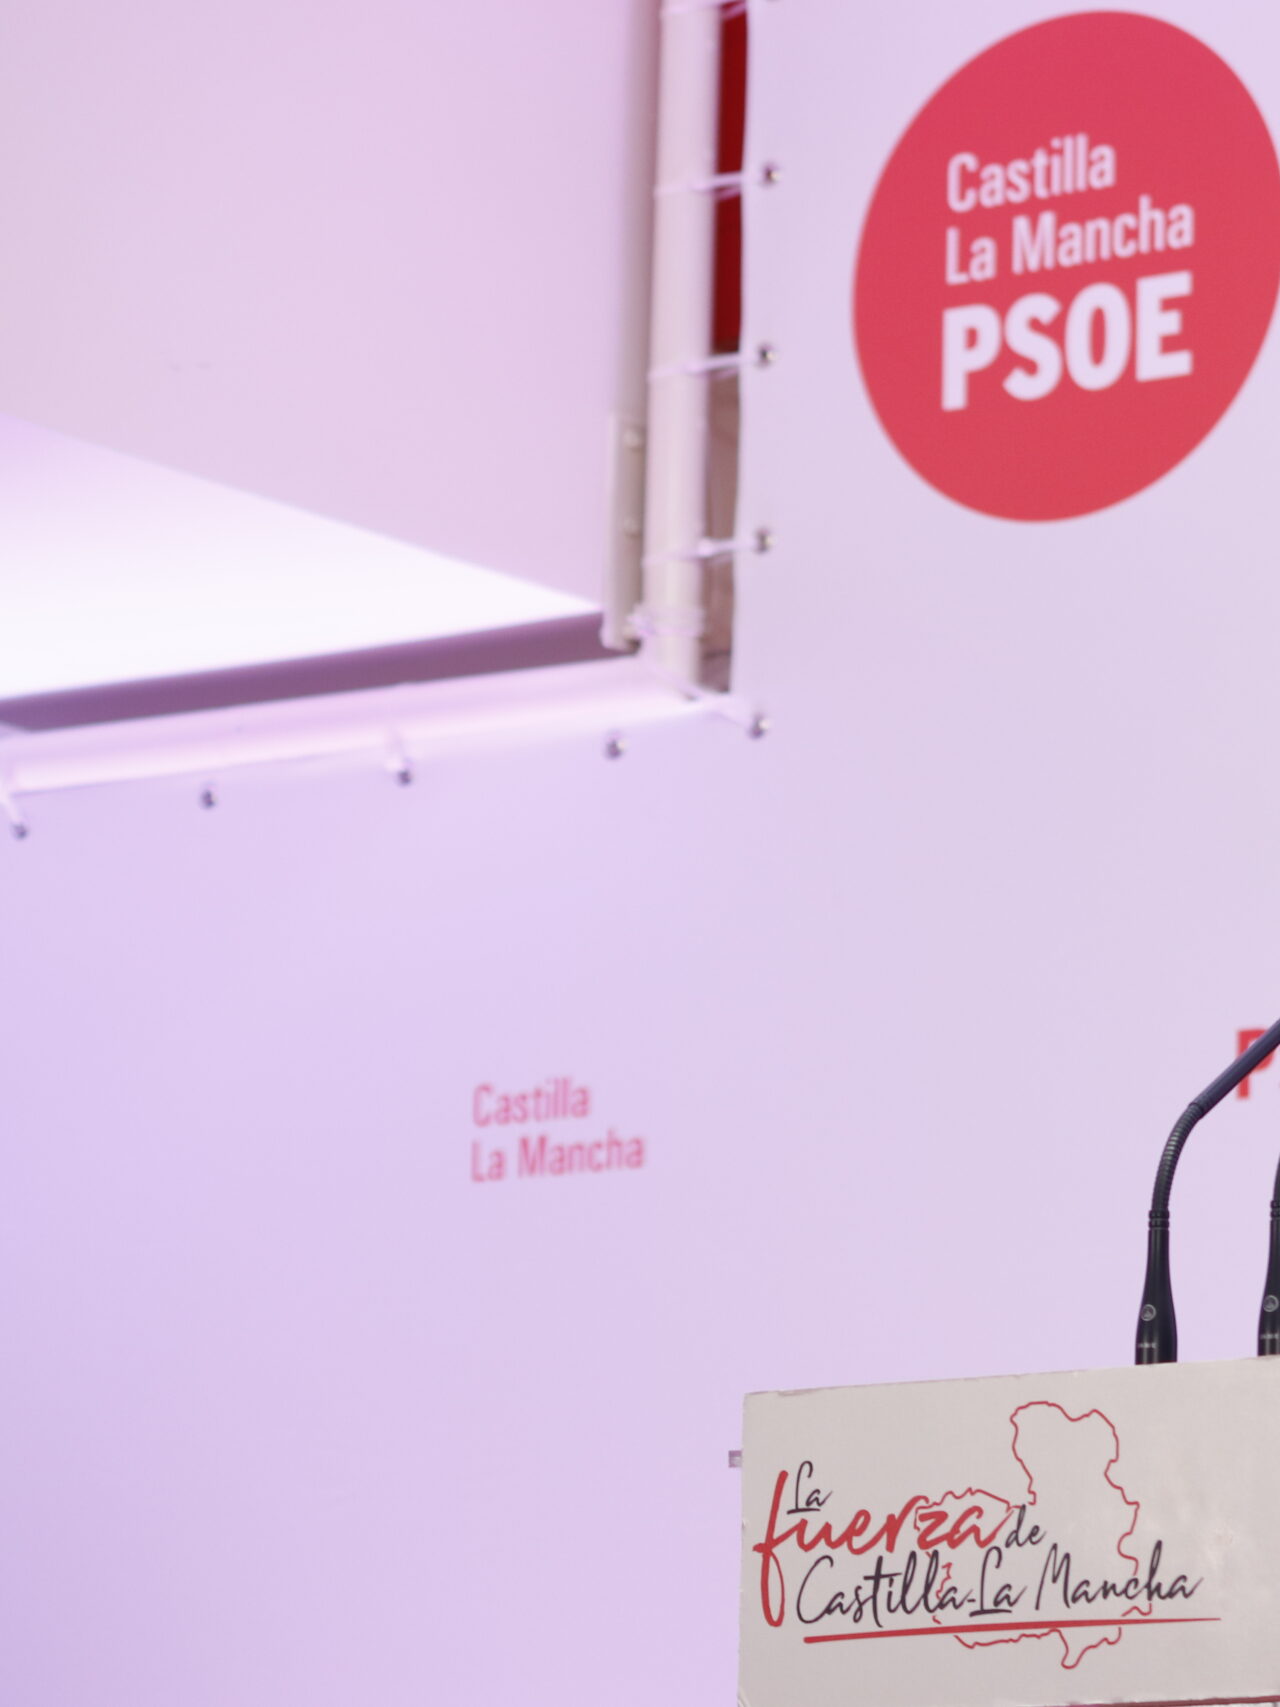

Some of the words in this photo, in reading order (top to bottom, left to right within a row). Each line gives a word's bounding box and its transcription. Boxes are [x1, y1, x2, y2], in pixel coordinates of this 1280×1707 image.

[947, 134, 1116, 213] Castilla
[946, 227, 996, 286] La
[1012, 195, 1195, 275] Mancha
[942, 270, 1193, 412] PSOE
[472, 1077, 592, 1128] Castilla
[471, 1138, 507, 1183] La
[517, 1126, 646, 1179] Mancha
[787, 1461, 832, 1514] La
[753, 1470, 1014, 1628] fuerza
[1005, 1504, 1046, 1548] de
[1035, 1540, 1204, 1611] Mancha
